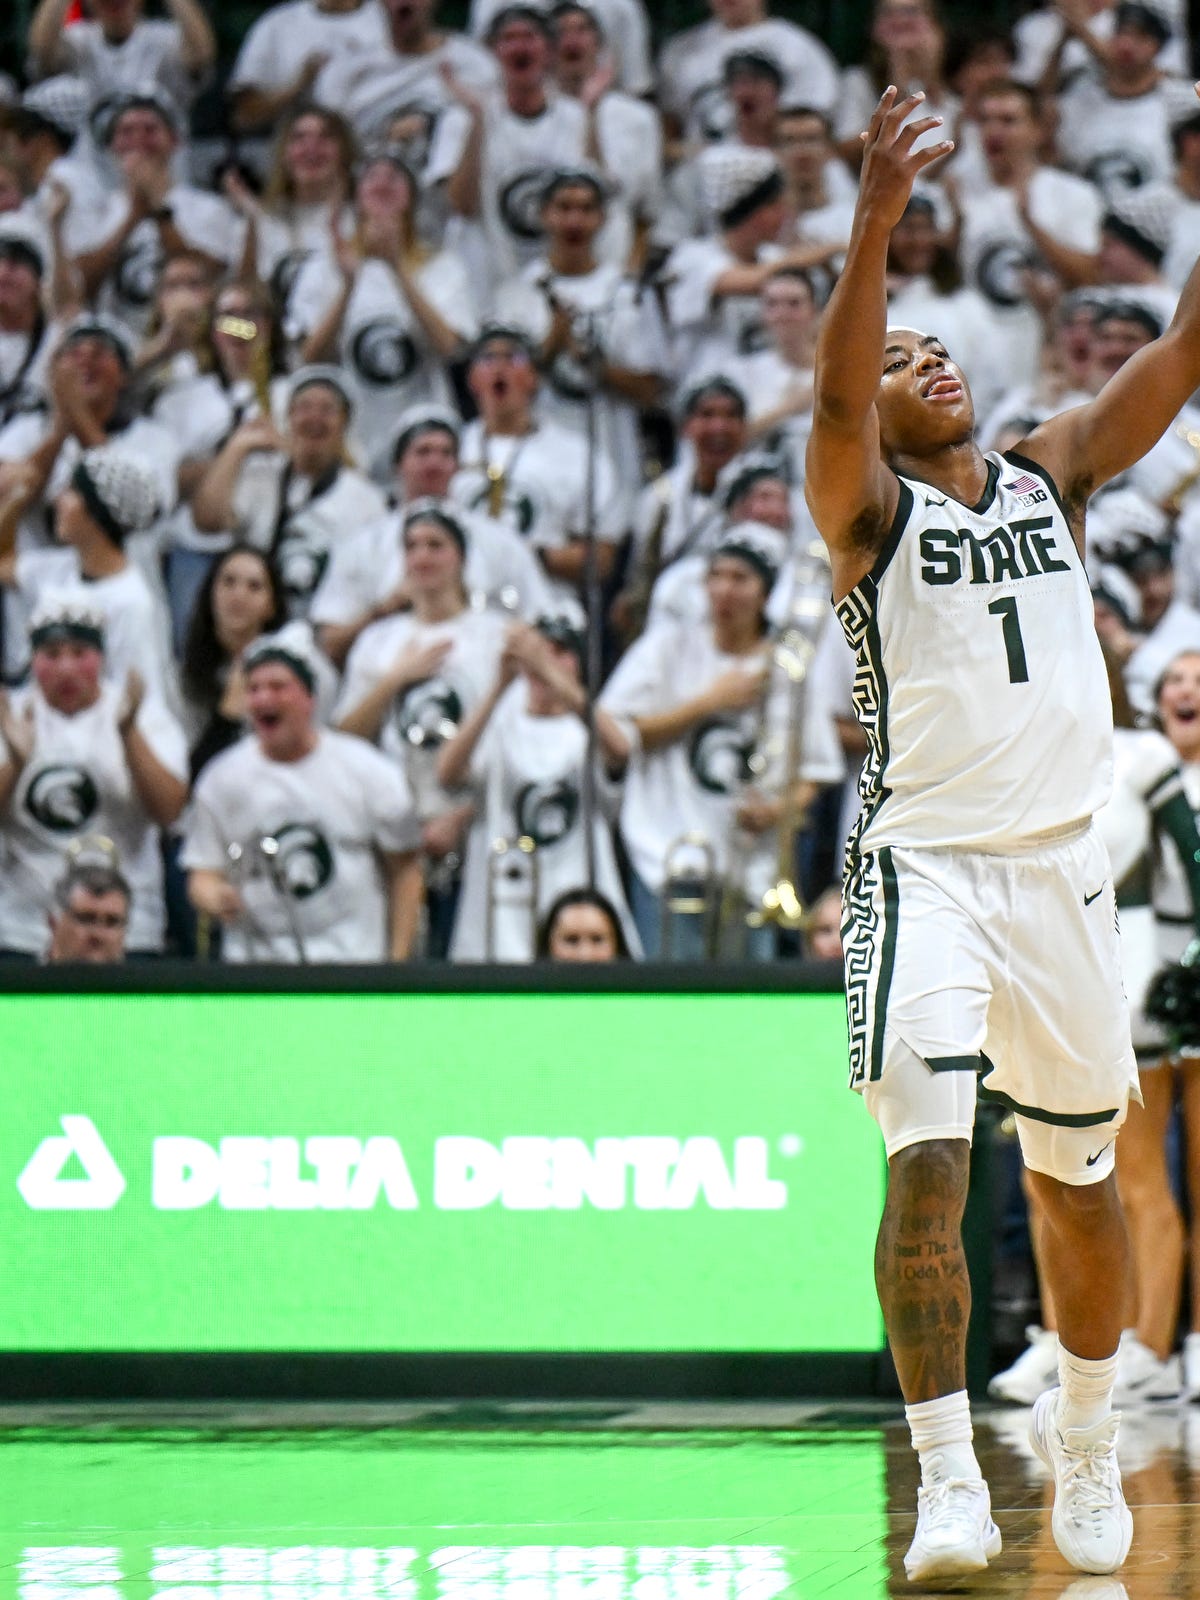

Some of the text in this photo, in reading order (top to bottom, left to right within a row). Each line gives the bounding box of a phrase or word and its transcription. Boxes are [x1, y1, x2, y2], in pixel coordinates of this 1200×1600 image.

[919, 516, 1072, 586] STATE
[988, 596, 1029, 684] 1
[152, 1136, 788, 1210] DELTA DENTAL
